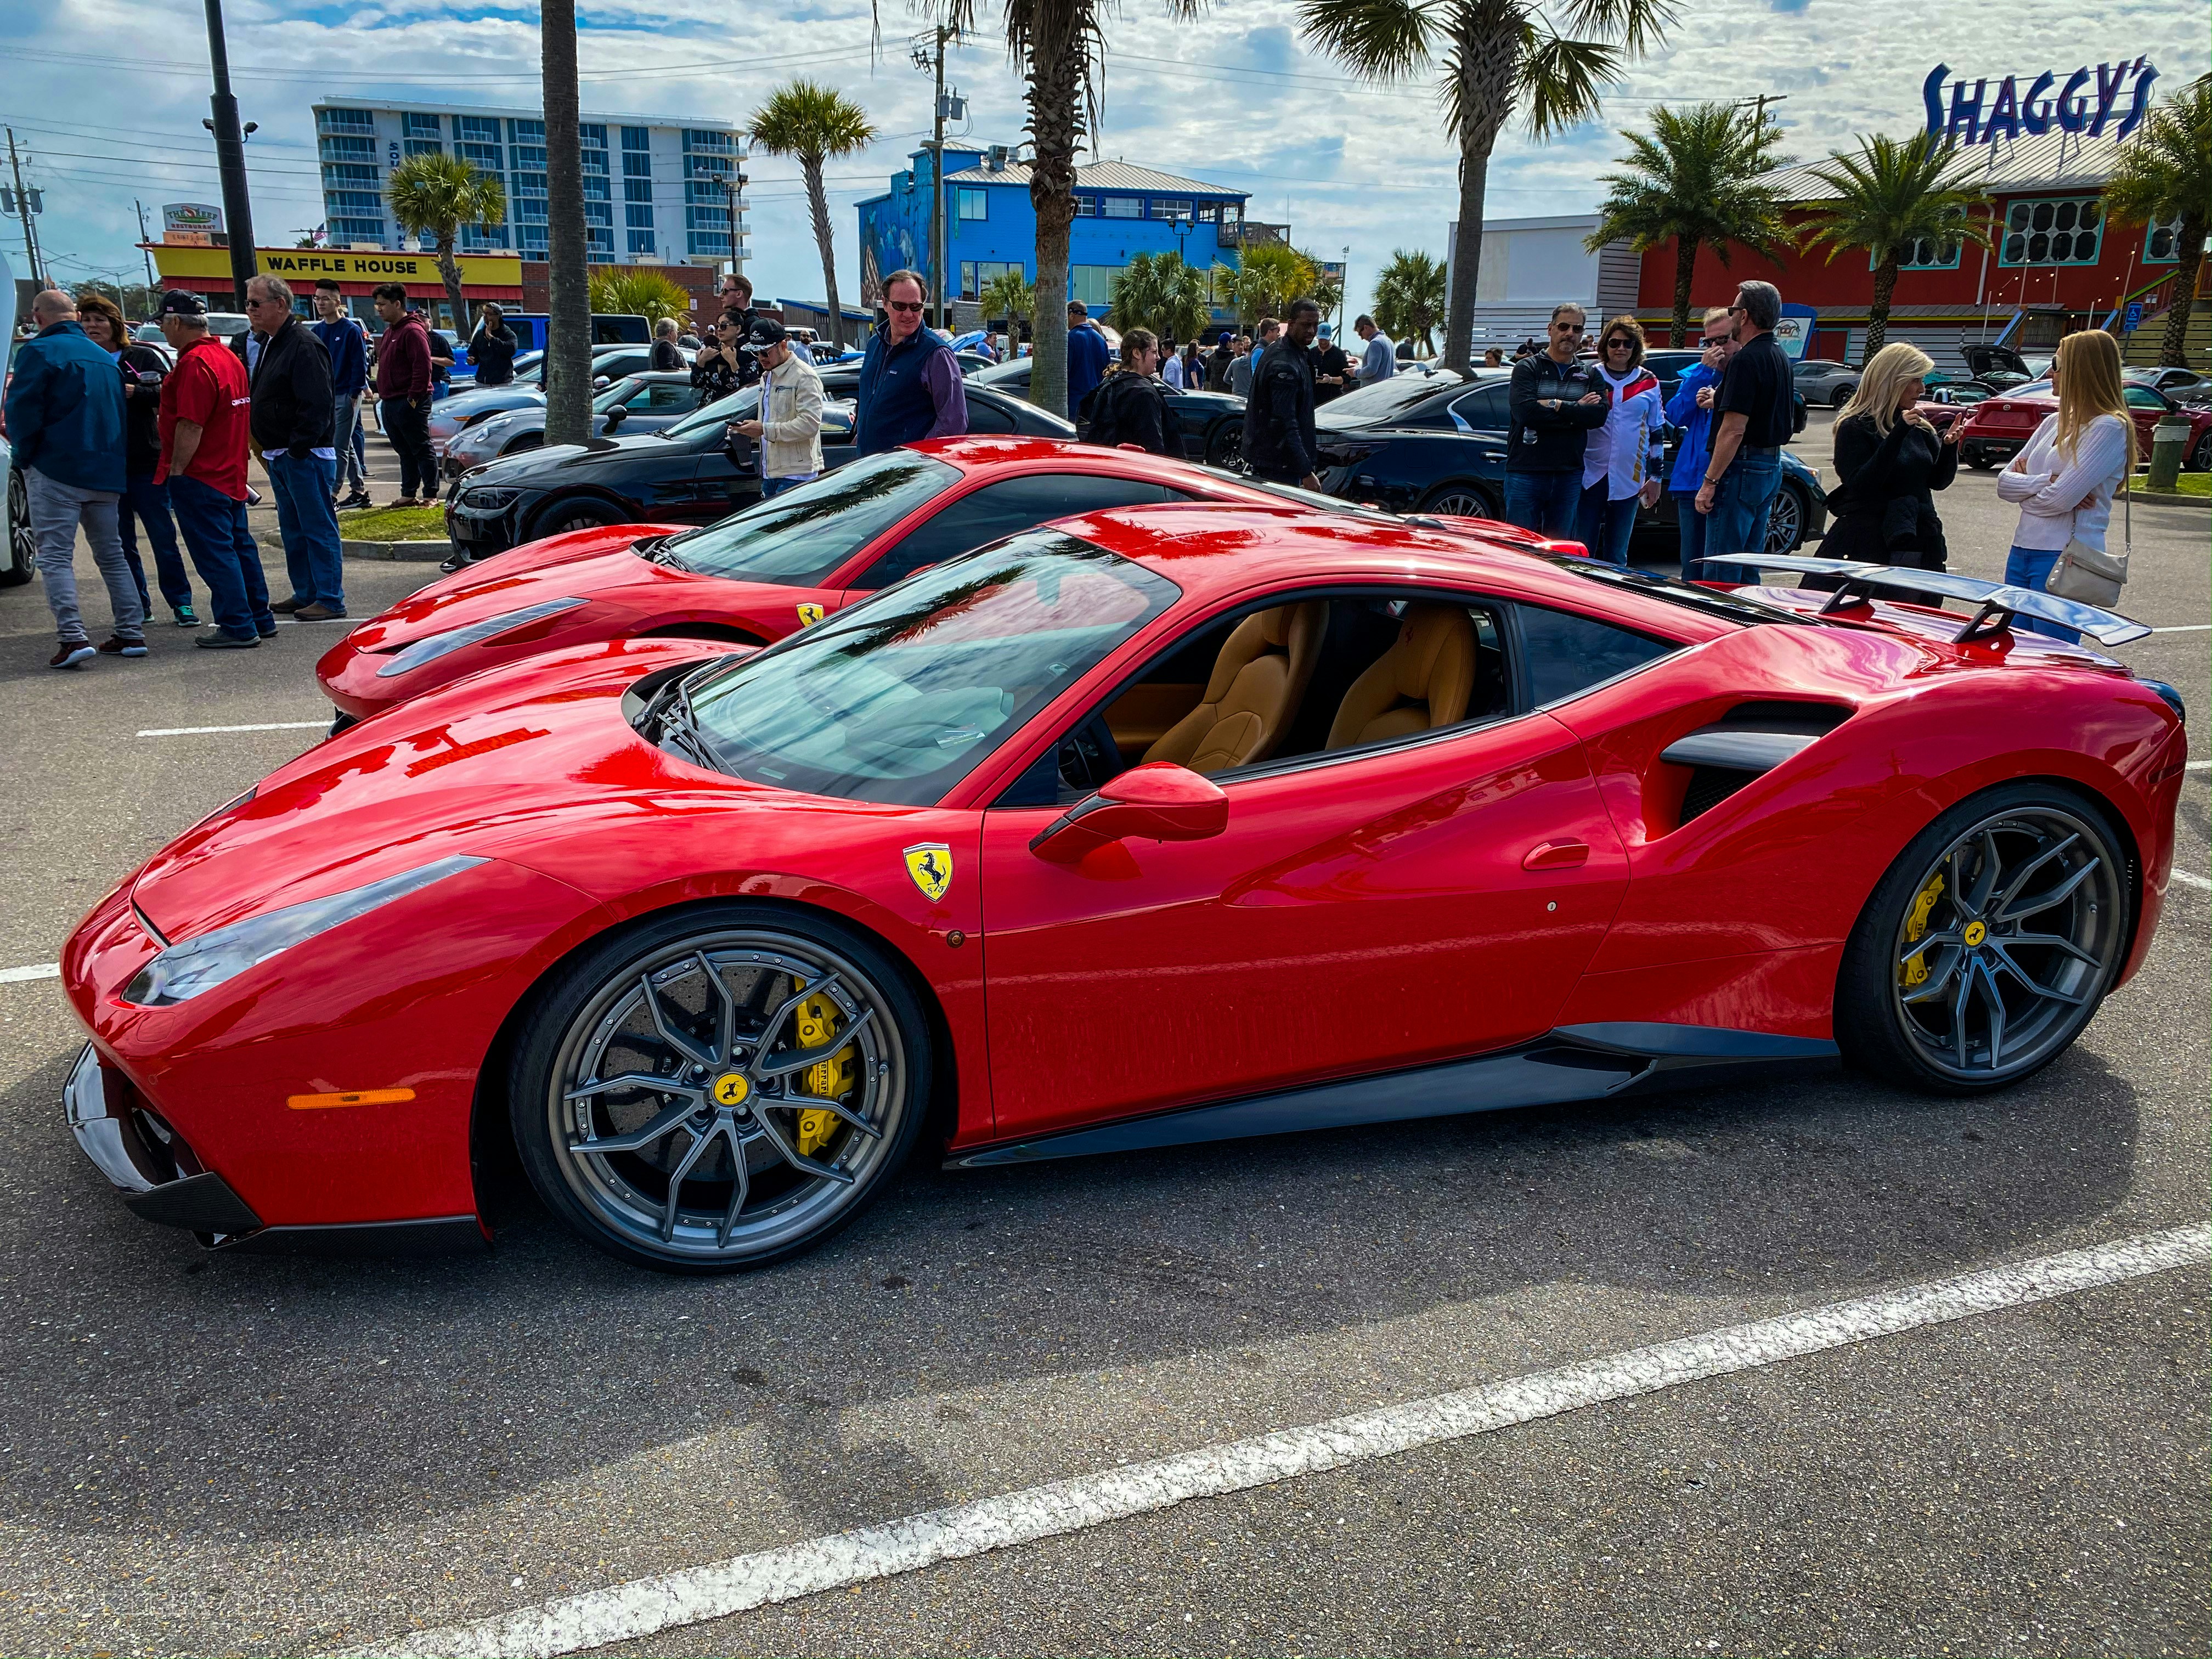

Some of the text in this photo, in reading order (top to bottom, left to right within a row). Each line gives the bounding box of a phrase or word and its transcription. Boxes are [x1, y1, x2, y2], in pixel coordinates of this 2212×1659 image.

[1923, 53, 2161, 165] SHAGGY'S
[267, 257, 417, 274] WAFFLE HOUSE
